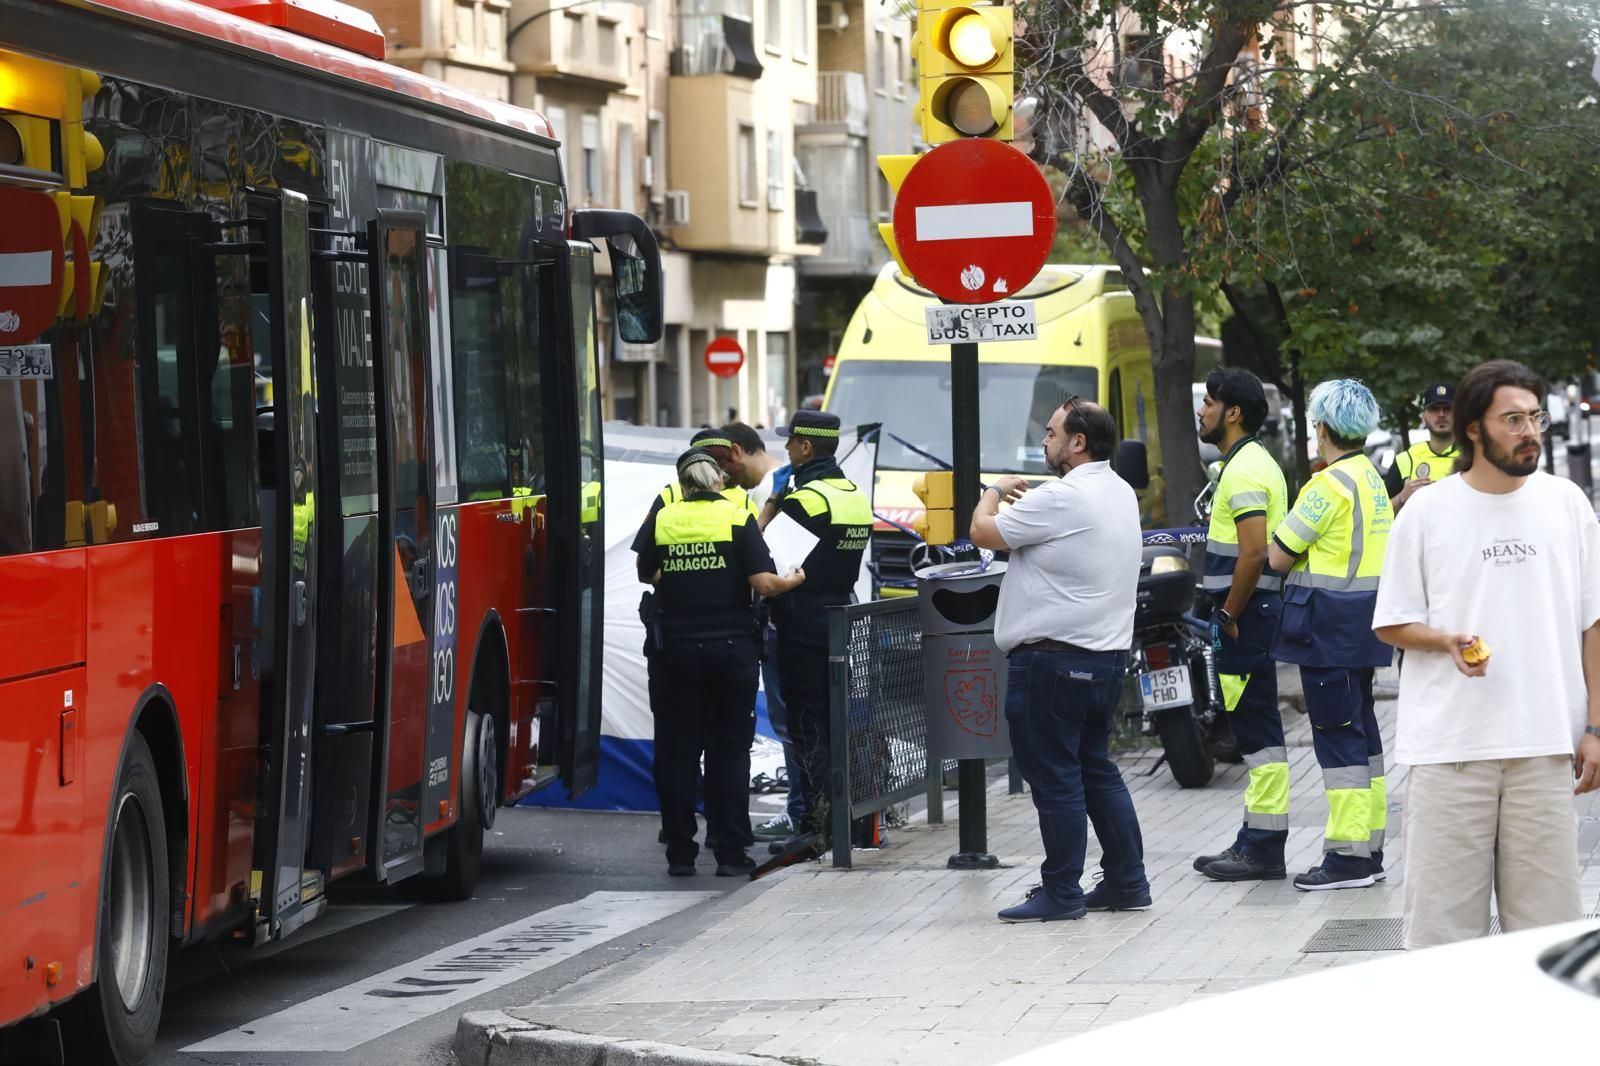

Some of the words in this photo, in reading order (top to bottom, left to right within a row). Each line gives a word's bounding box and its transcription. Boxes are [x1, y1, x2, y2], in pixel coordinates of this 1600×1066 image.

[331, 159, 350, 219] EN
[935, 305, 1026, 321] CEPTO
[337, 308, 373, 367] VIAJE
[993, 322, 1035, 337] TAXI
[1306, 490, 1330, 514] 061
[1179, 532, 1206, 543] PASAR
[668, 542, 716, 556] POLICIA
[1482, 544, 1537, 560] BEANS
[663, 555, 727, 572] ZARAGOZA
[1152, 669, 1185, 688] 1351
[1152, 686, 1178, 704] FHD
[495, 921, 609, 944] BUS
